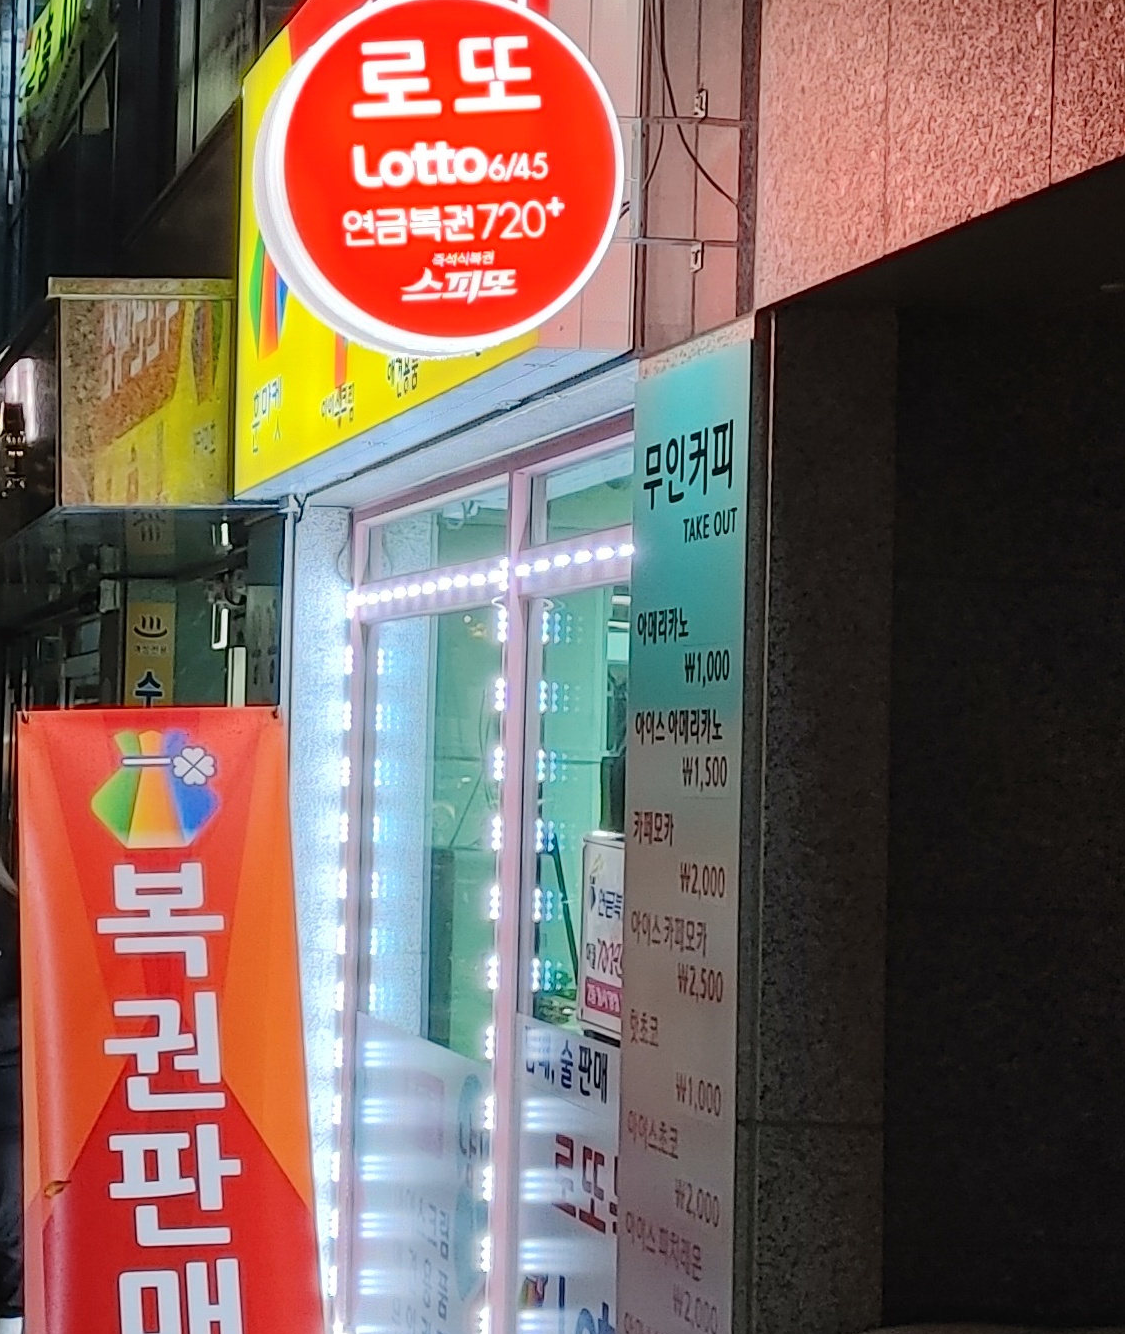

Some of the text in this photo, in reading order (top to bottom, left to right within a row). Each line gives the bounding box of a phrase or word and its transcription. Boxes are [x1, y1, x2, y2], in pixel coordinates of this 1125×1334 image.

[352, 36, 541, 118] 로또
[400, 267, 518, 303] 스피또
[643, 419, 735, 510] 무인커피
[683, 507, 738, 544] TAKE OUT
[637, 607, 689, 645] 아메리카노
[684, 649, 730, 686] ₩1,000
[635, 708, 723, 747] 아이스 아메리카노
[682, 755, 728, 792] ₩1,500
[633, 811, 674, 846] 카페모카
[680, 863, 725, 899] ₩2,000
[631, 910, 708, 957] 아이스 카페모카
[677, 962, 723, 1003] ₩2,500
[578, 1045, 608, 1104] 판매
